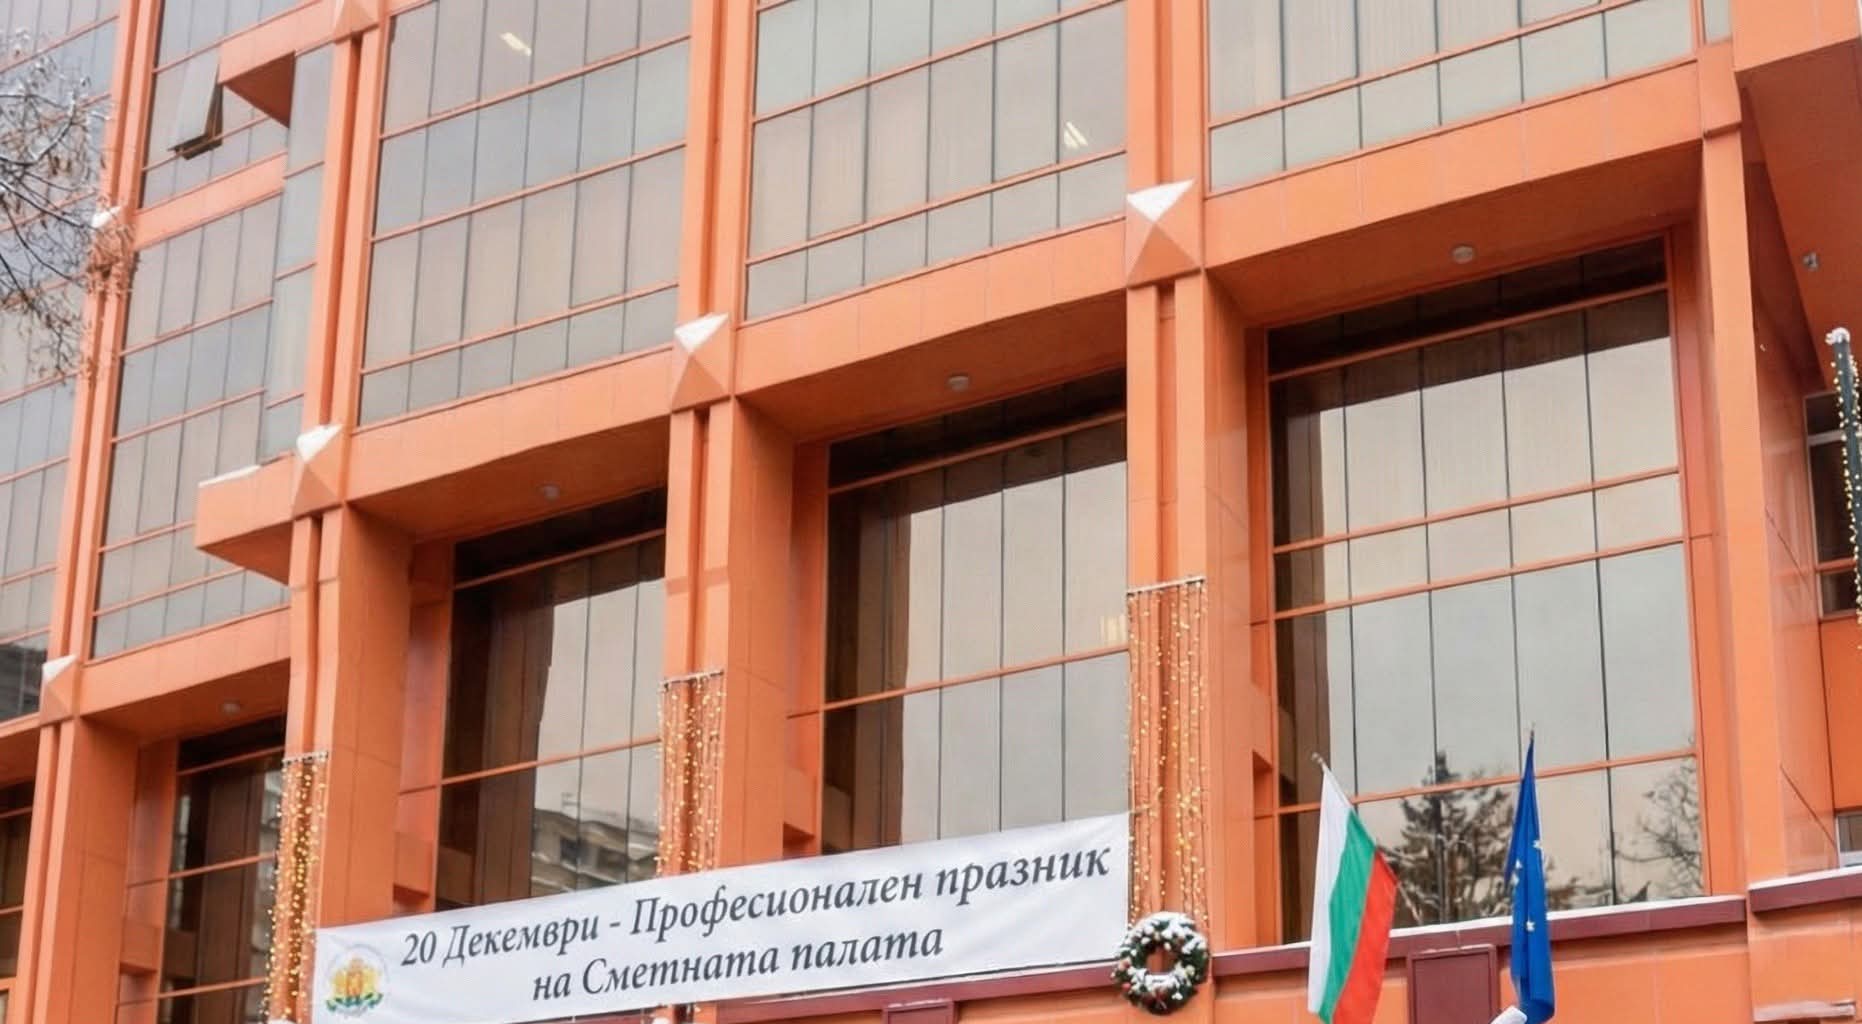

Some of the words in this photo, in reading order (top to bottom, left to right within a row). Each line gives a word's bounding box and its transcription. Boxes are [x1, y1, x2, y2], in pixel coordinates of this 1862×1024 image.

[400, 931, 437, 967] 20
[442, 916, 600, 971] Декември
[630, 869, 923, 943] Професионален
[936, 846, 1112, 907] празник
[532, 971, 572, 1001] на
[583, 945, 780, 996] Сметната
[791, 927, 944, 972] палата
